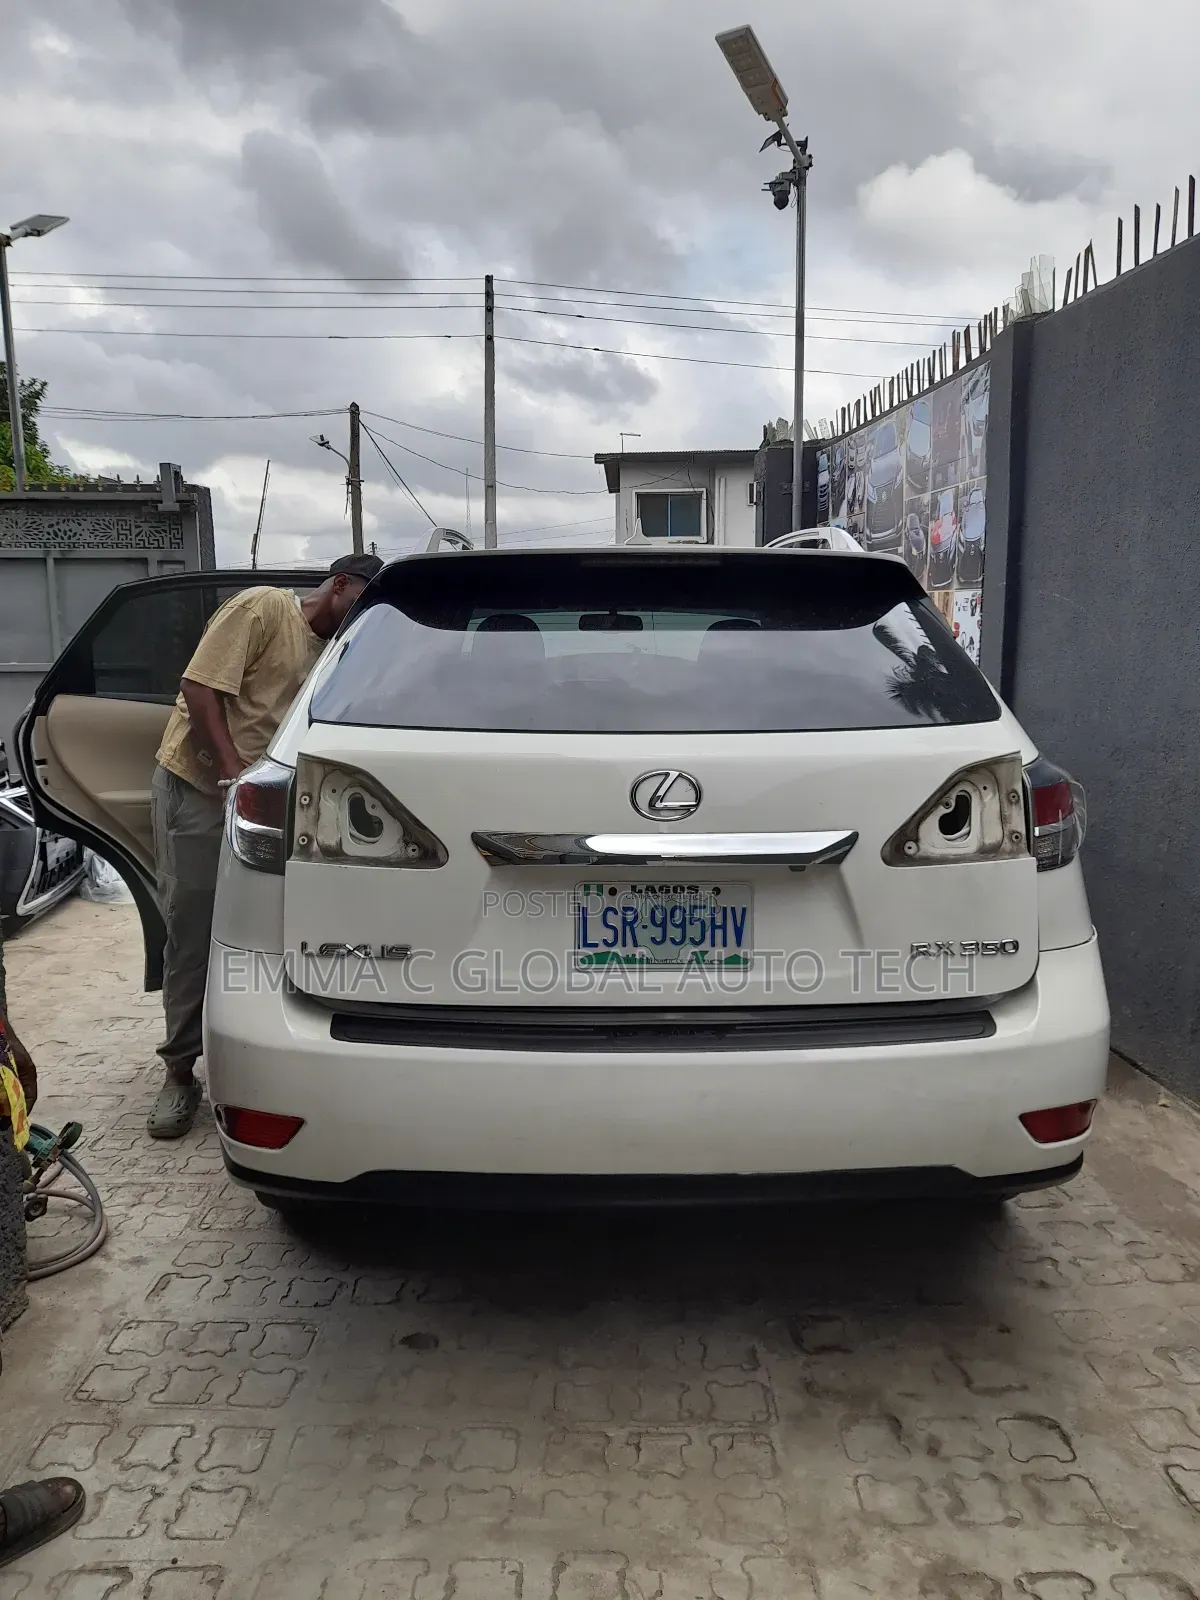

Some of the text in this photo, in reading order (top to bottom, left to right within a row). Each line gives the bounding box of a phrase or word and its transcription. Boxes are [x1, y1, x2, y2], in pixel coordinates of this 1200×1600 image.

[630, 884, 700, 895] LAGOS
[300, 940, 412, 960] LEXUS
[910, 938, 1020, 957] RX 350
